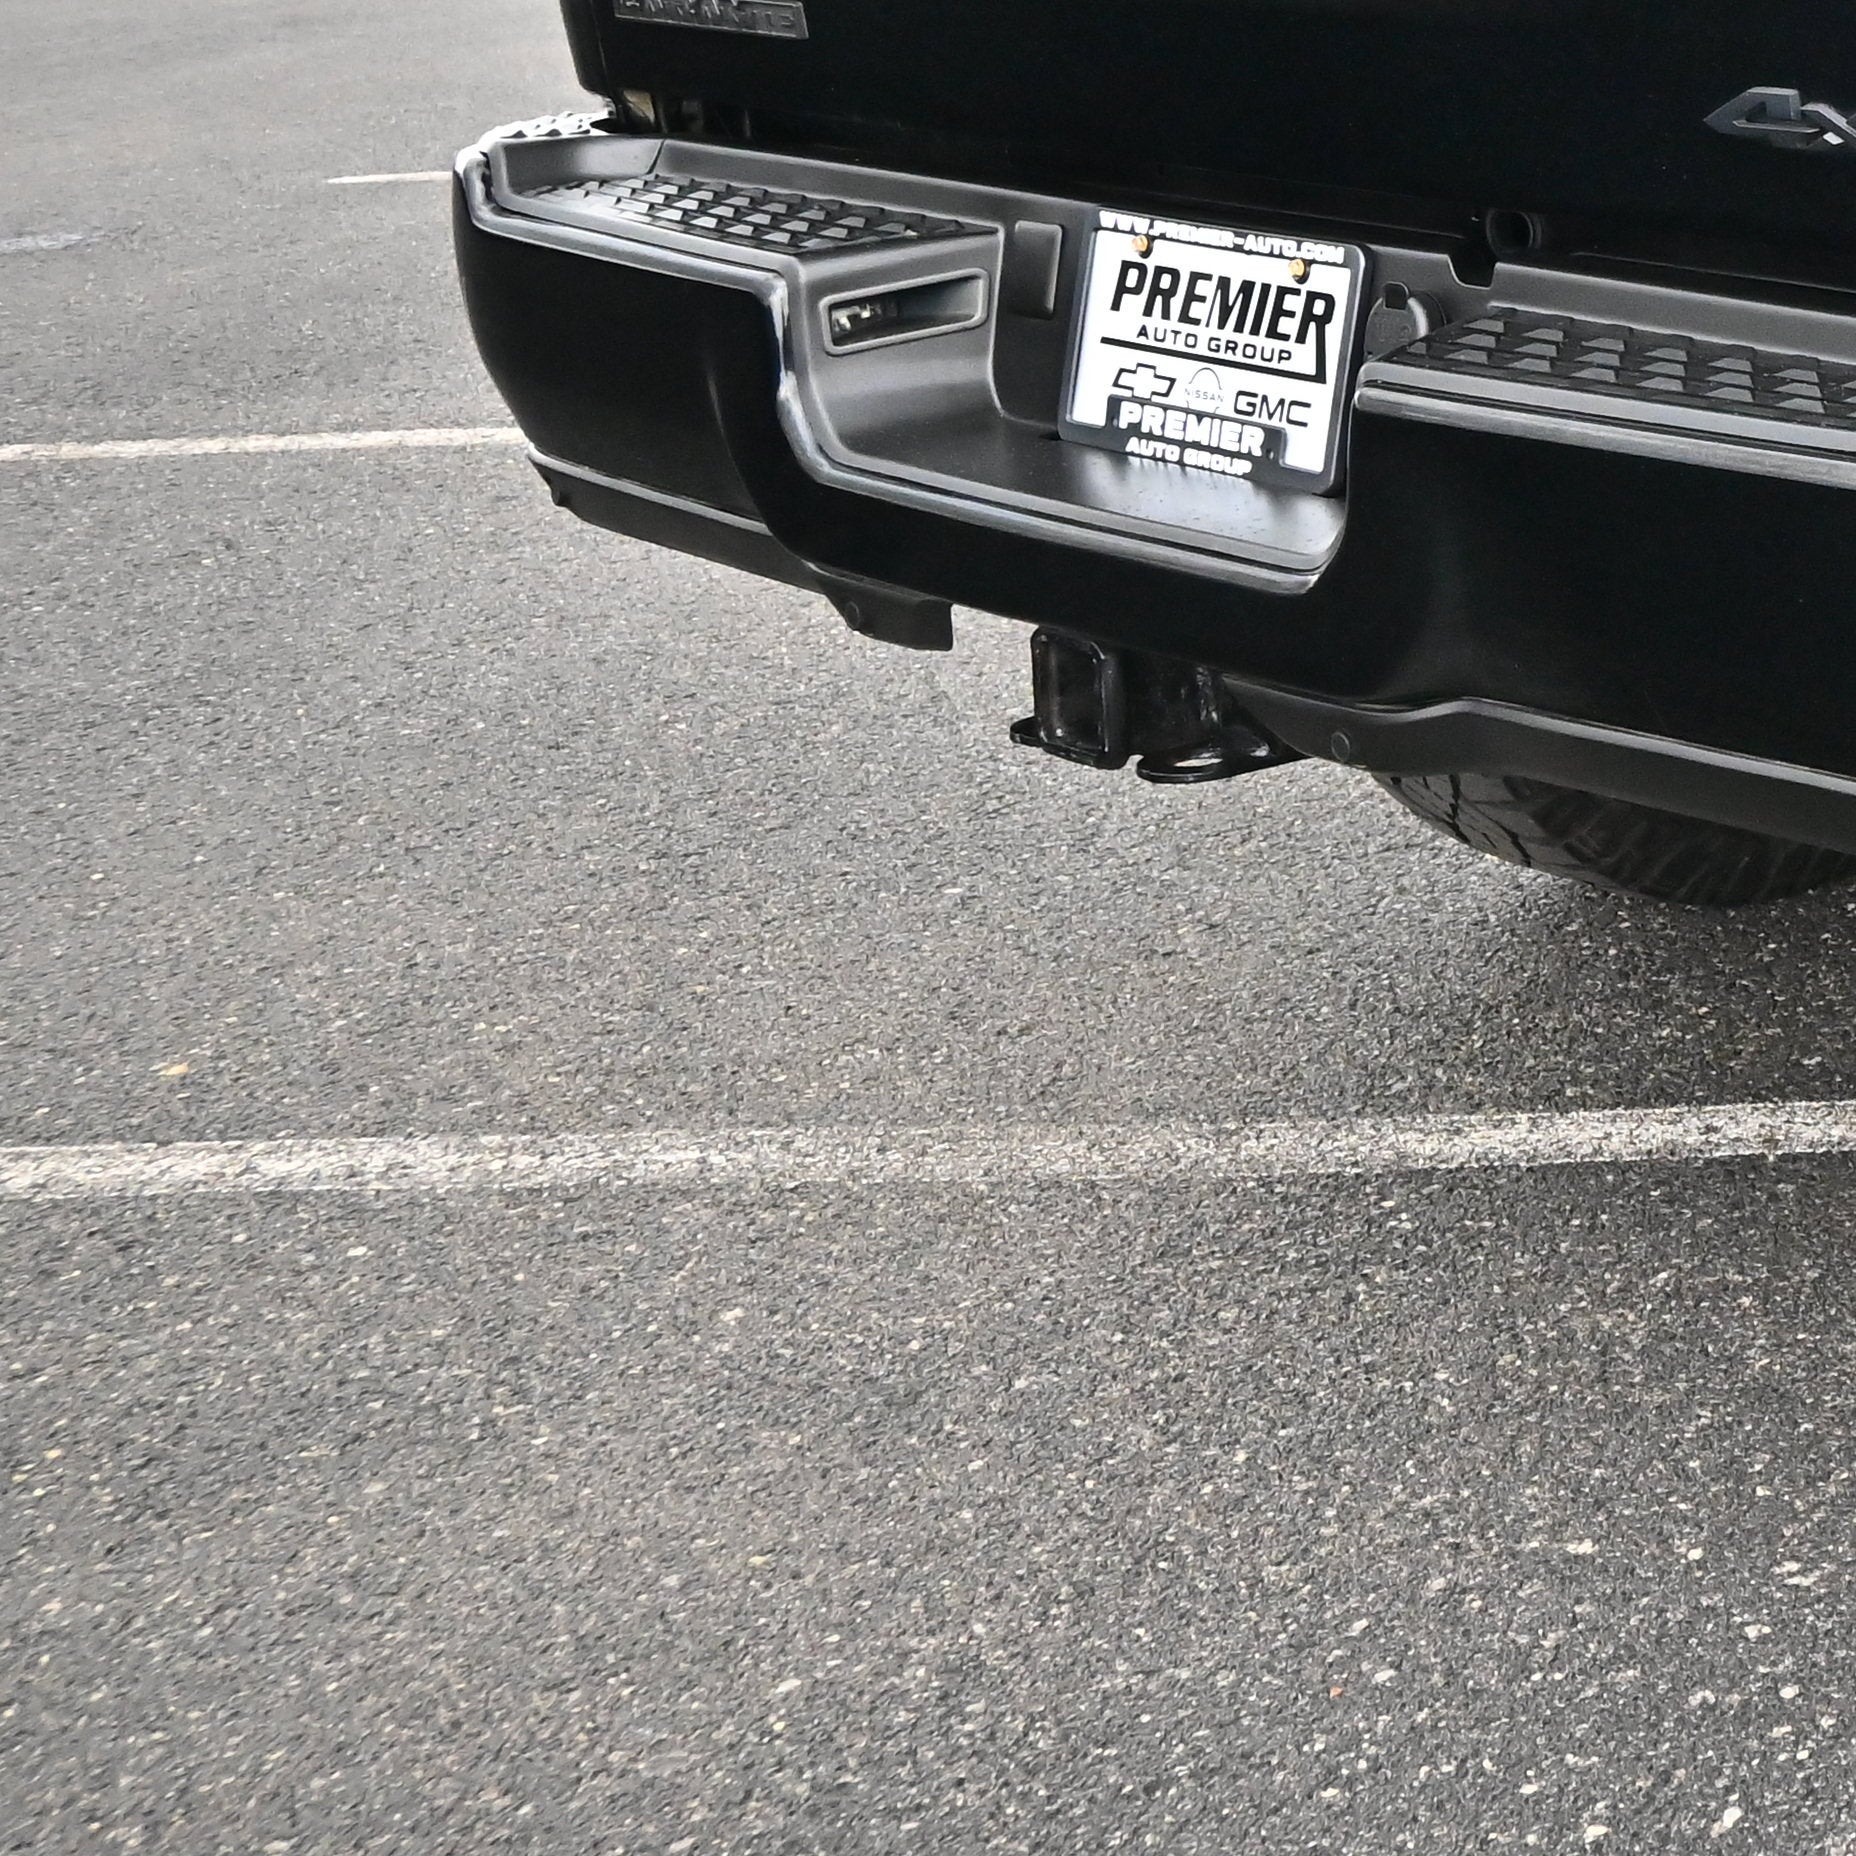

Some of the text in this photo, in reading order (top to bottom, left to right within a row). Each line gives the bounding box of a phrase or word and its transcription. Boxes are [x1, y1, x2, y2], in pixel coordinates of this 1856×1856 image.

[1099, 211, 1345, 265] WWW.PREMIER-AUTO.COM
[1109, 259, 1337, 348] PREMIER
[1136, 325, 1293, 364] AUTO GROUP
[1118, 401, 1265, 457] PREMIER
[1184, 387, 1312, 427] NISSAN GMC
[1125, 438, 1253, 476] AUTO GROUP
